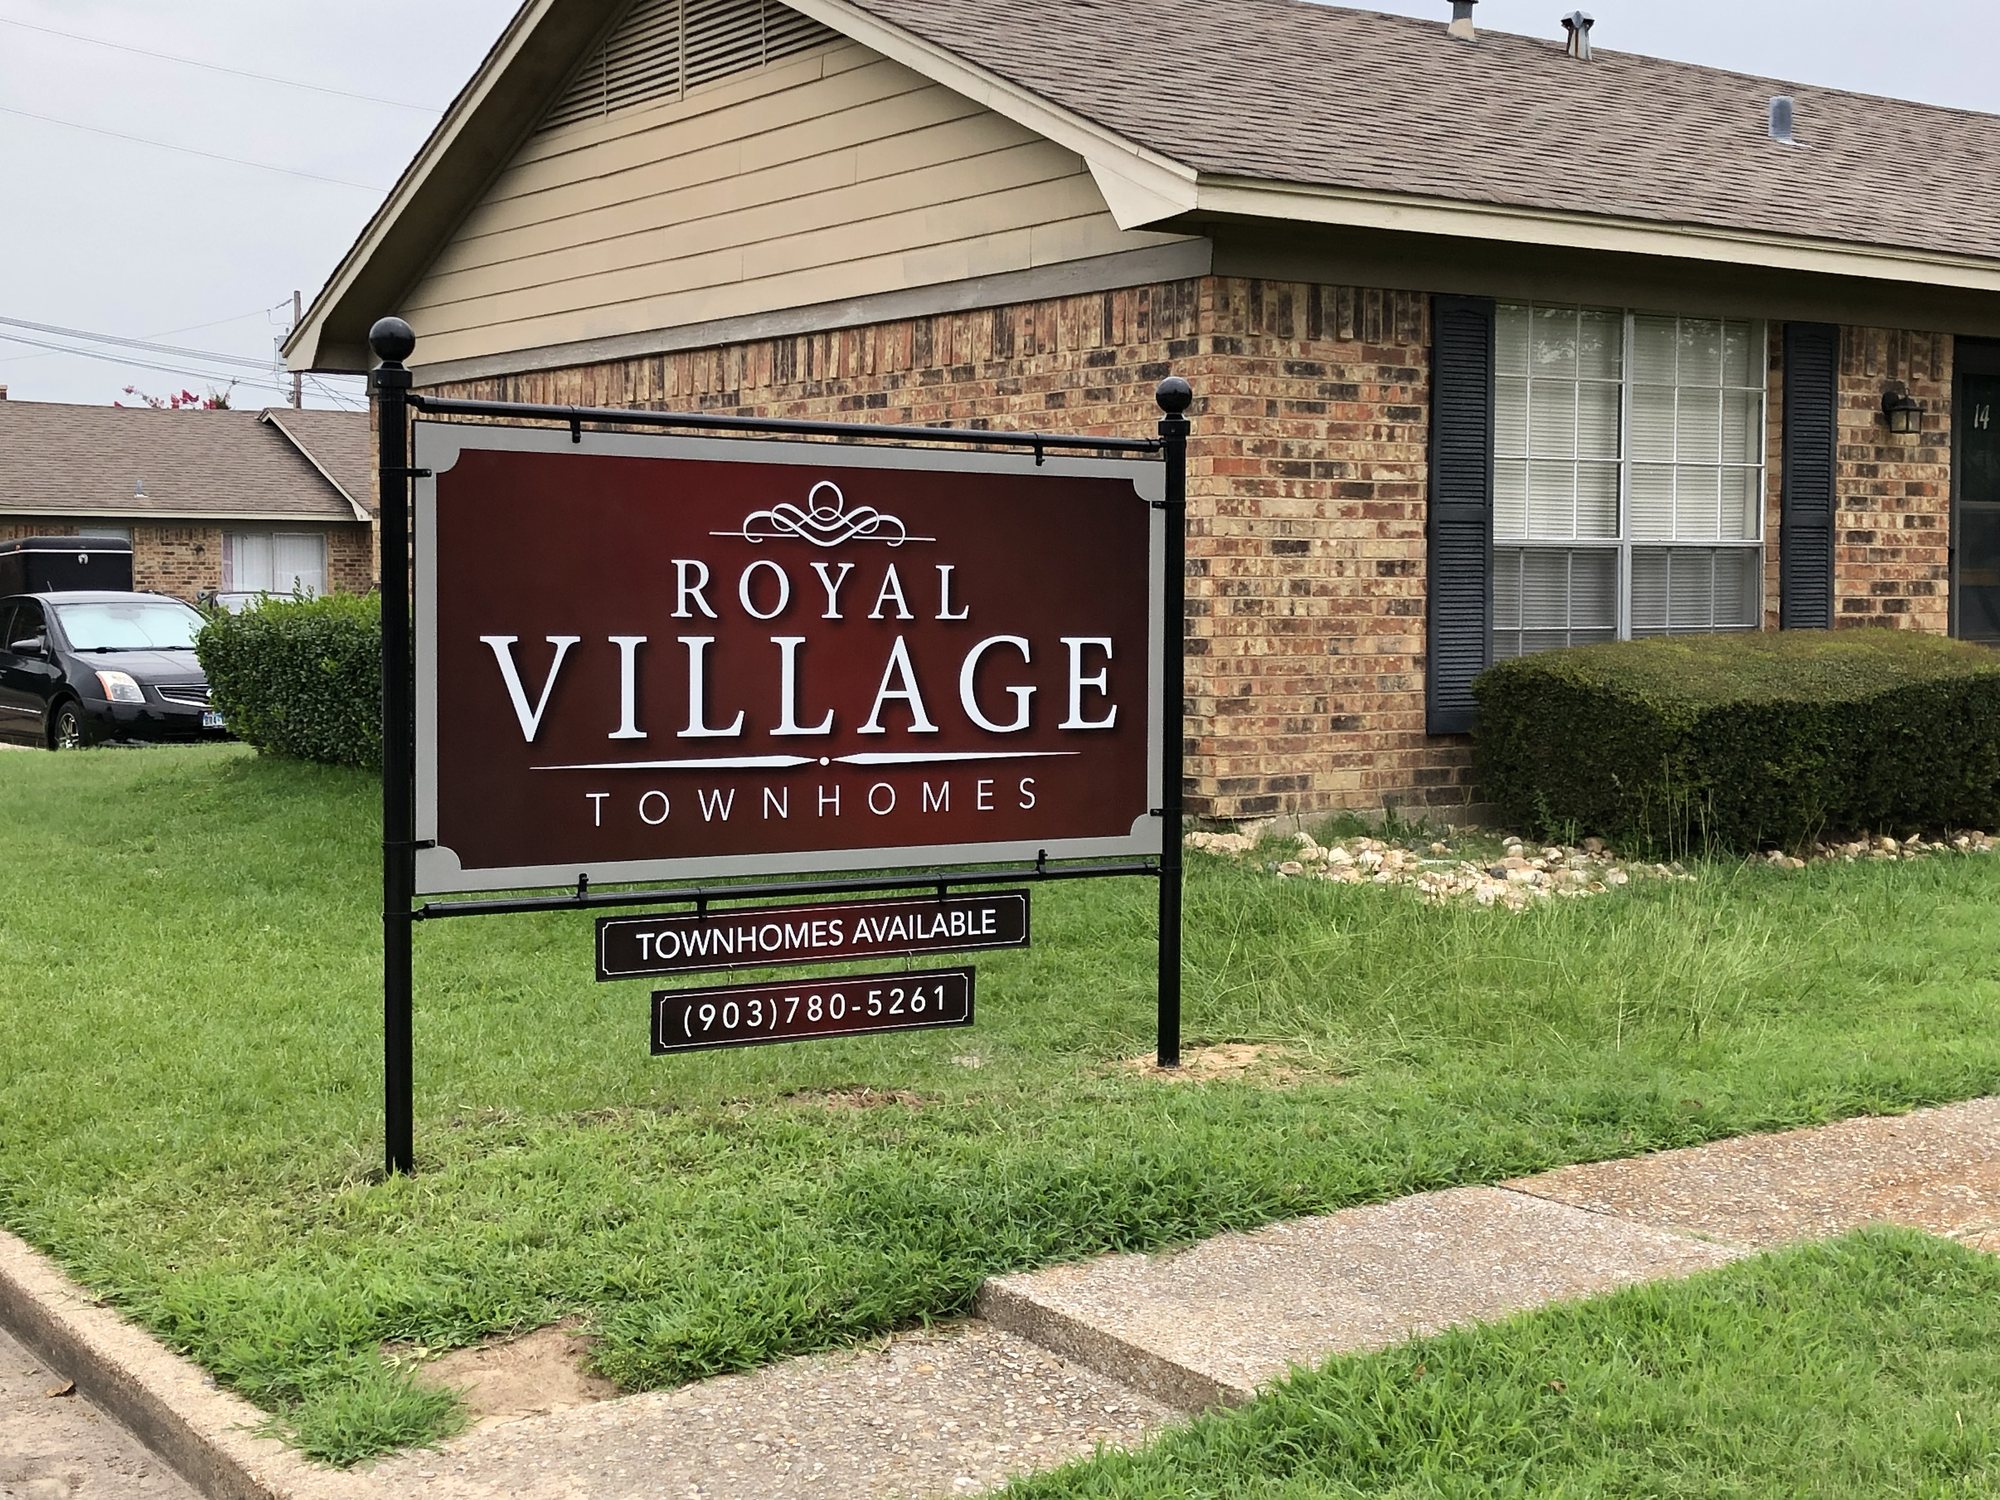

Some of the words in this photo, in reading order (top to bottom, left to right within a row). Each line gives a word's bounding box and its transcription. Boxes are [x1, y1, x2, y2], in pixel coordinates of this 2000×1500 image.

[1974, 403, 1990, 430] 14
[670, 559, 970, 620] ROYAL
[479, 634, 1118, 743] VILLAGE
[585, 777, 1037, 827] TOWNHOMES
[635, 918, 845, 960] TOWNHOMES
[851, 908, 997, 944] AVAILABLE
[683, 985, 945, 1038] (903)780-5261
